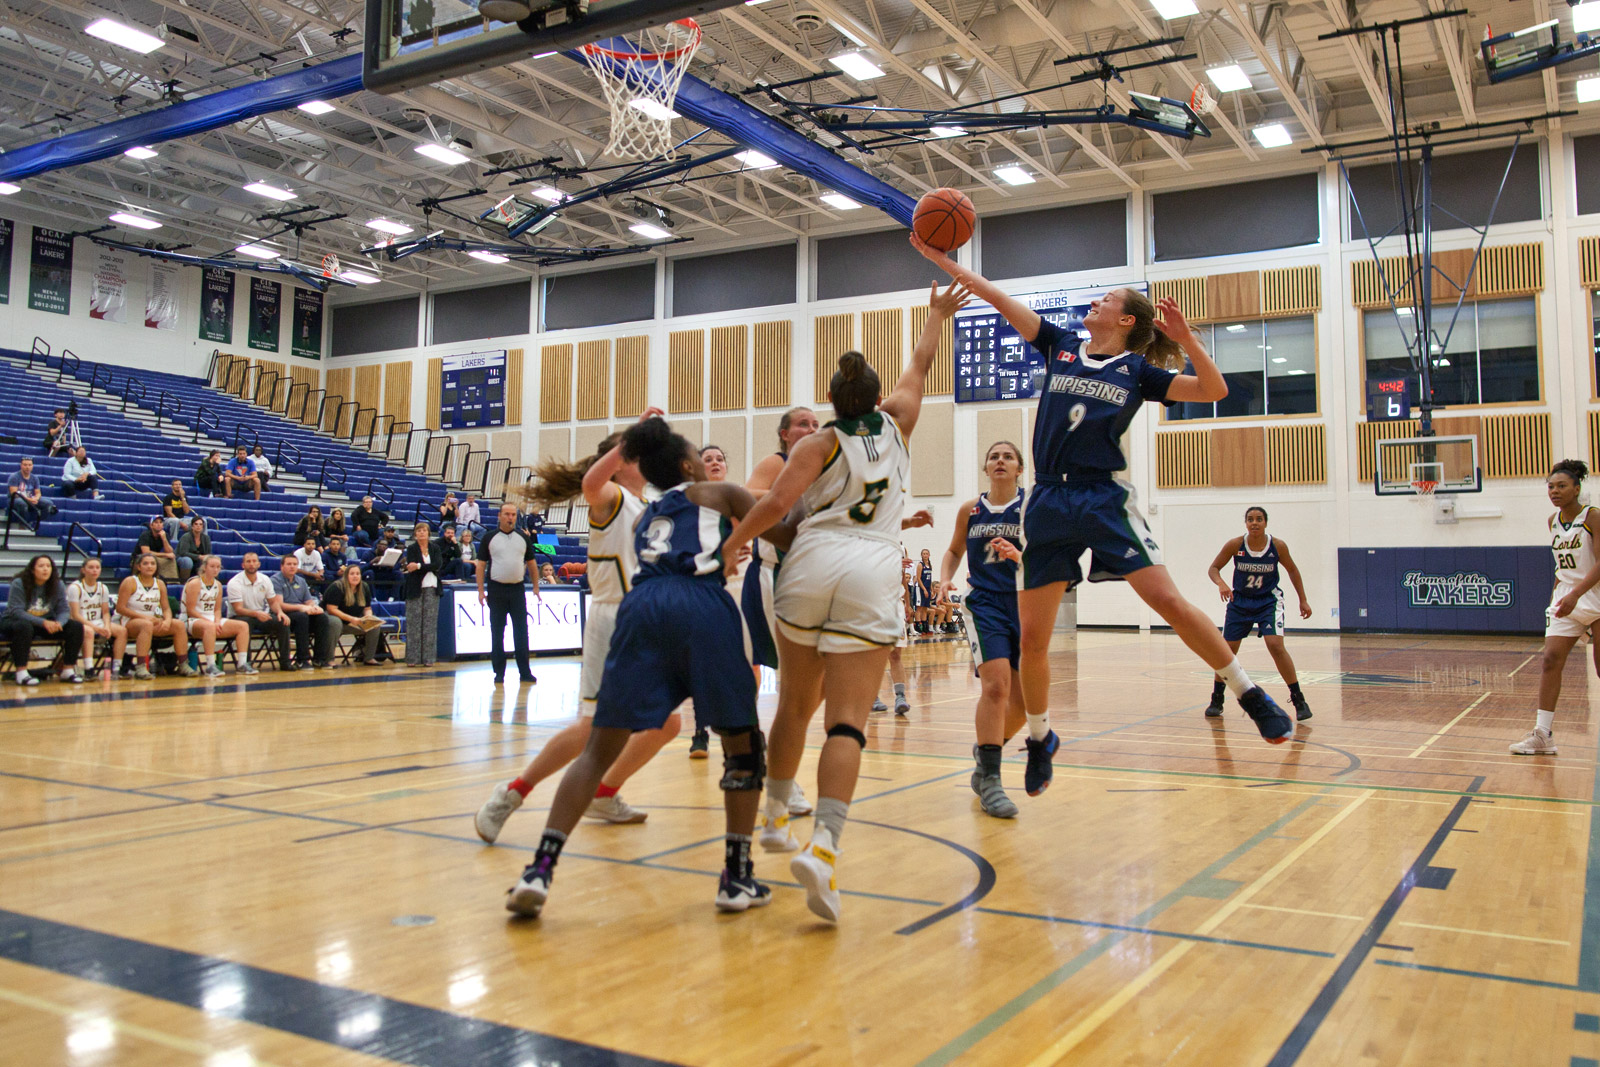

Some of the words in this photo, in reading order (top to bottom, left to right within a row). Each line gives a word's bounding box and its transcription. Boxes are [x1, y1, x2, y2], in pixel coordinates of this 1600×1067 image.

[35, 235, 70, 247] CHAMPIONS
[40, 248, 65, 259] LAKERS
[208, 283, 229, 293] LAKERS
[33, 292, 65, 302] VOLLEYBALL
[256, 294, 275, 304] LAKERS
[1028, 296, 1068, 310] LAKERS
[34, 301, 65, 311] 2012-2013
[299, 303, 318, 312] LAKERS
[965, 329, 971, 338] 9
[974, 328, 980, 338] 0
[988, 327, 995, 337] 2
[965, 341, 971, 351] 8
[988, 340, 995, 349] 2
[960, 354, 971, 364] 22
[975, 353, 981, 362] 0
[989, 352, 995, 362] 3
[1005, 345, 1024, 362] 24
[462, 358, 485, 367] LAKERS
[960, 366, 971, 376] 24
[988, 364, 995, 374] 2
[965, 378, 972, 388] 3
[974, 377, 981, 387] 0
[988, 376, 995, 386] 0
[1009, 378, 1017, 391] 3
[1022, 379, 1029, 389] 2
[1378, 380, 1404, 393] 4:42
[1048, 374, 1130, 407] NIPISSING
[1387, 396, 1401, 417] 6
[1067, 402, 1087, 432] 9
[641, 516, 675, 563] 3
[1237, 562, 1274, 573] NIPISSING
[1558, 553, 1577, 570] 20
[1245, 575, 1263, 588] 24
[1404, 572, 1446, 587] Home
[1447, 573, 1463, 590] of
[1464, 573, 1487, 584] the
[1411, 583, 1512, 606] LAKERS
[86, 610, 97, 621] 12
